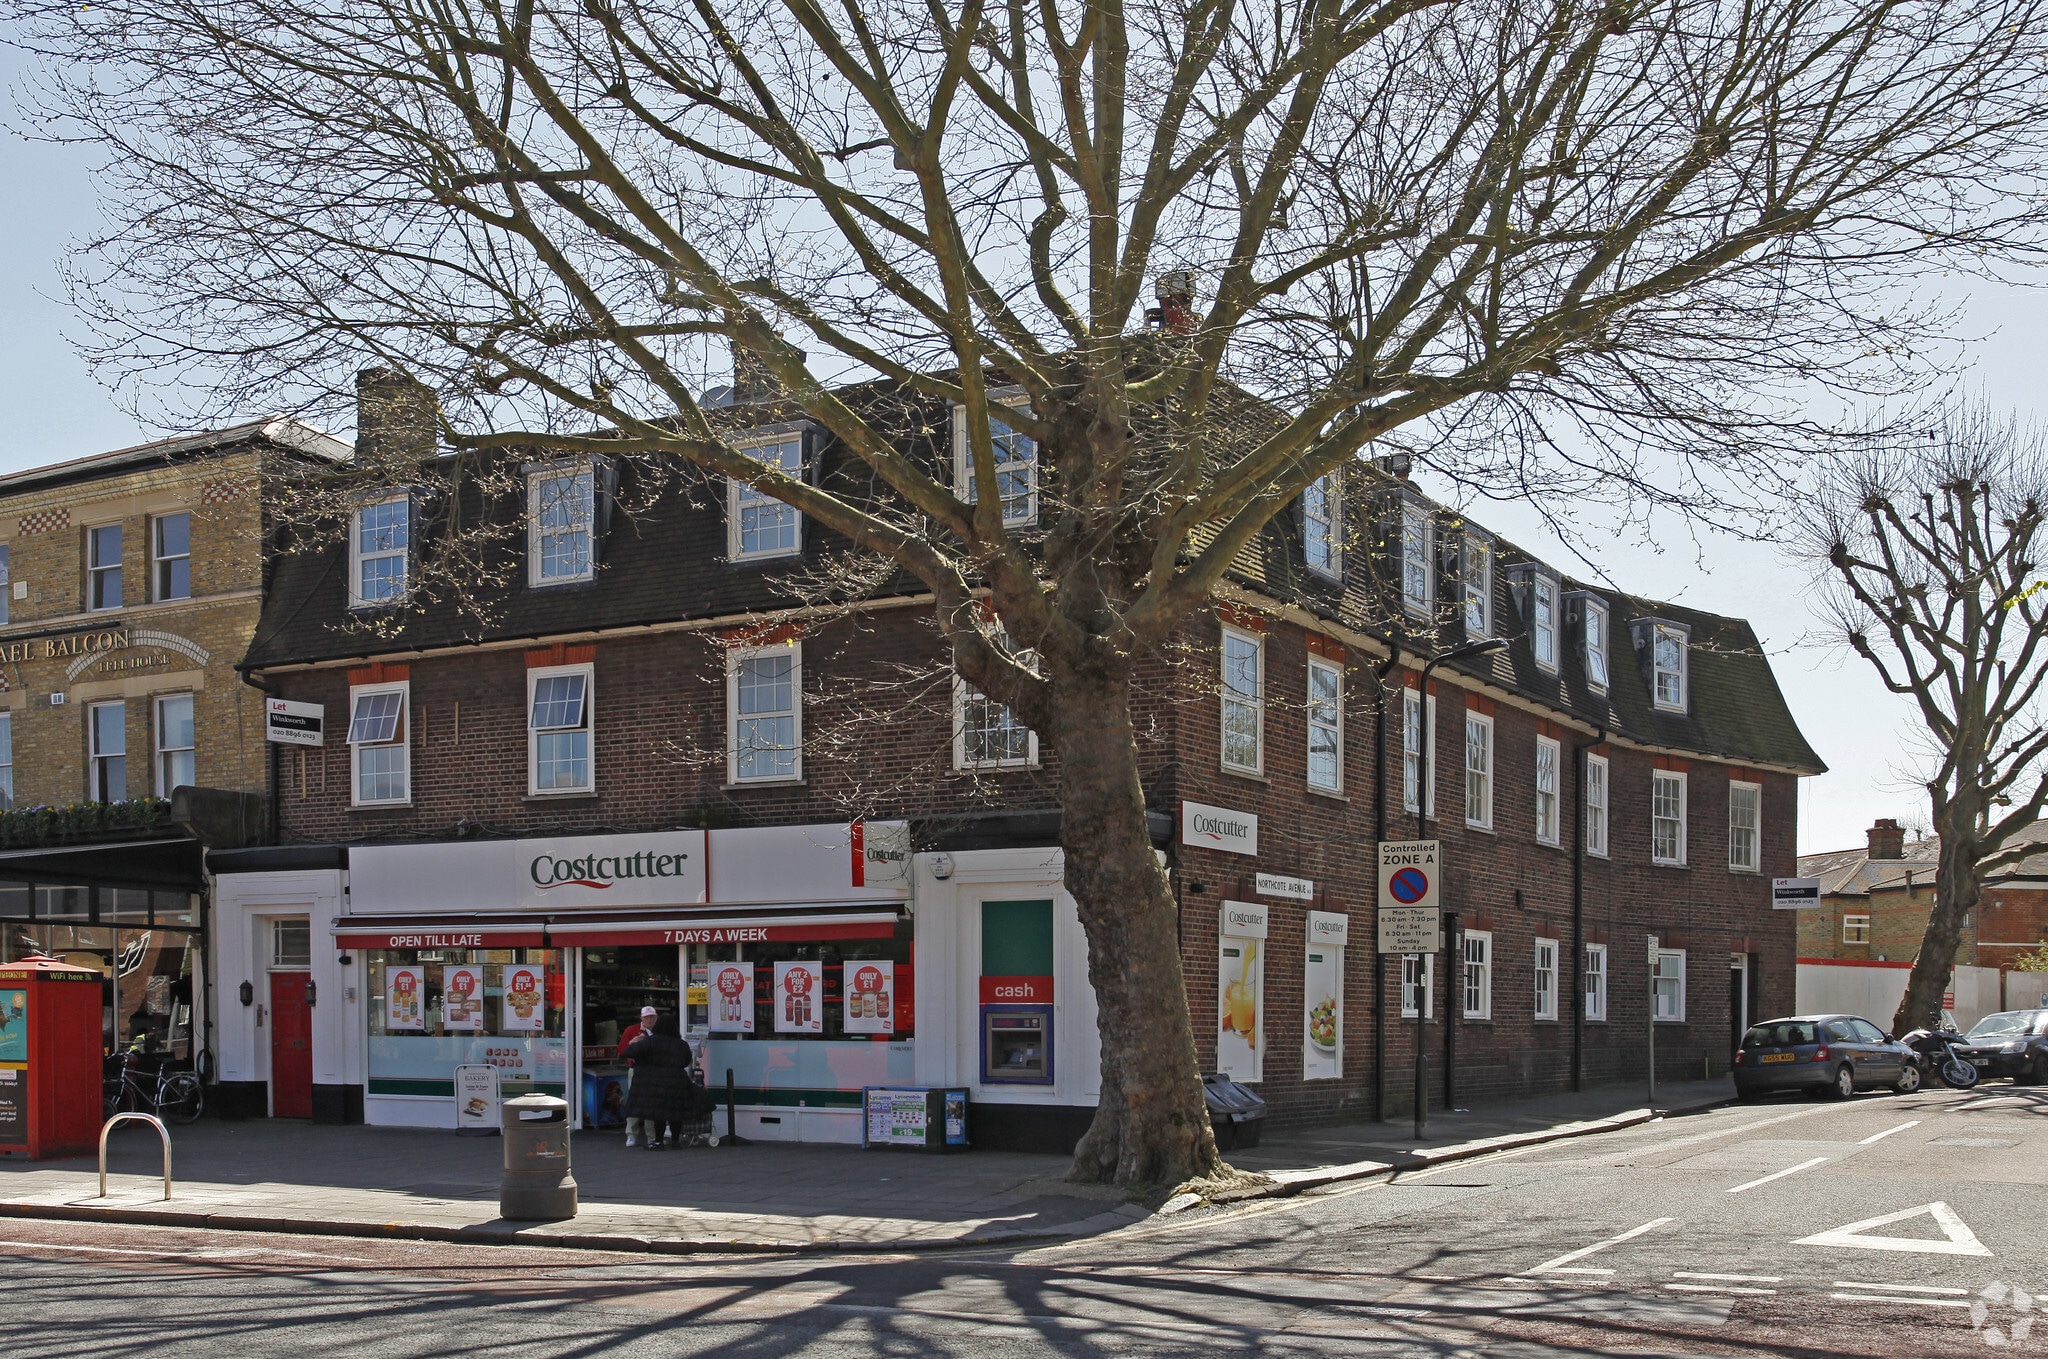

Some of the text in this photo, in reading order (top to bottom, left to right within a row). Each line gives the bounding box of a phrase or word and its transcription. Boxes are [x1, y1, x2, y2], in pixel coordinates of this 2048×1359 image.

[46, 628, 130, 658] BALCON
[99, 653, 171, 672] FREE HOUSE
[272, 702, 286, 710] Let
[272, 714, 306, 724] Winkworth
[286, 730, 302, 738] 8896
[1193, 814, 1248, 838] Costcutter
[1382, 844, 1435, 852] Controlled
[867, 848, 905, 862] Costcutter
[1383, 854, 1434, 864] ZONE A
[530, 850, 688, 885] Costcutter
[1258, 879, 1286, 891] NORTHCOTE
[1288, 882, 1306, 894] AVENUE
[1229, 911, 1263, 925] Costcutter
[1314, 920, 1344, 932] Costcutter
[390, 934, 482, 947] OPEN TILL LATE
[664, 928, 768, 943] 7 DAYS A WEEK
[50, 972, 84, 980] WiFi here
[793, 986, 804, 994] £2
[864, 980, 874, 988] £1
[995, 983, 1034, 996] cash
